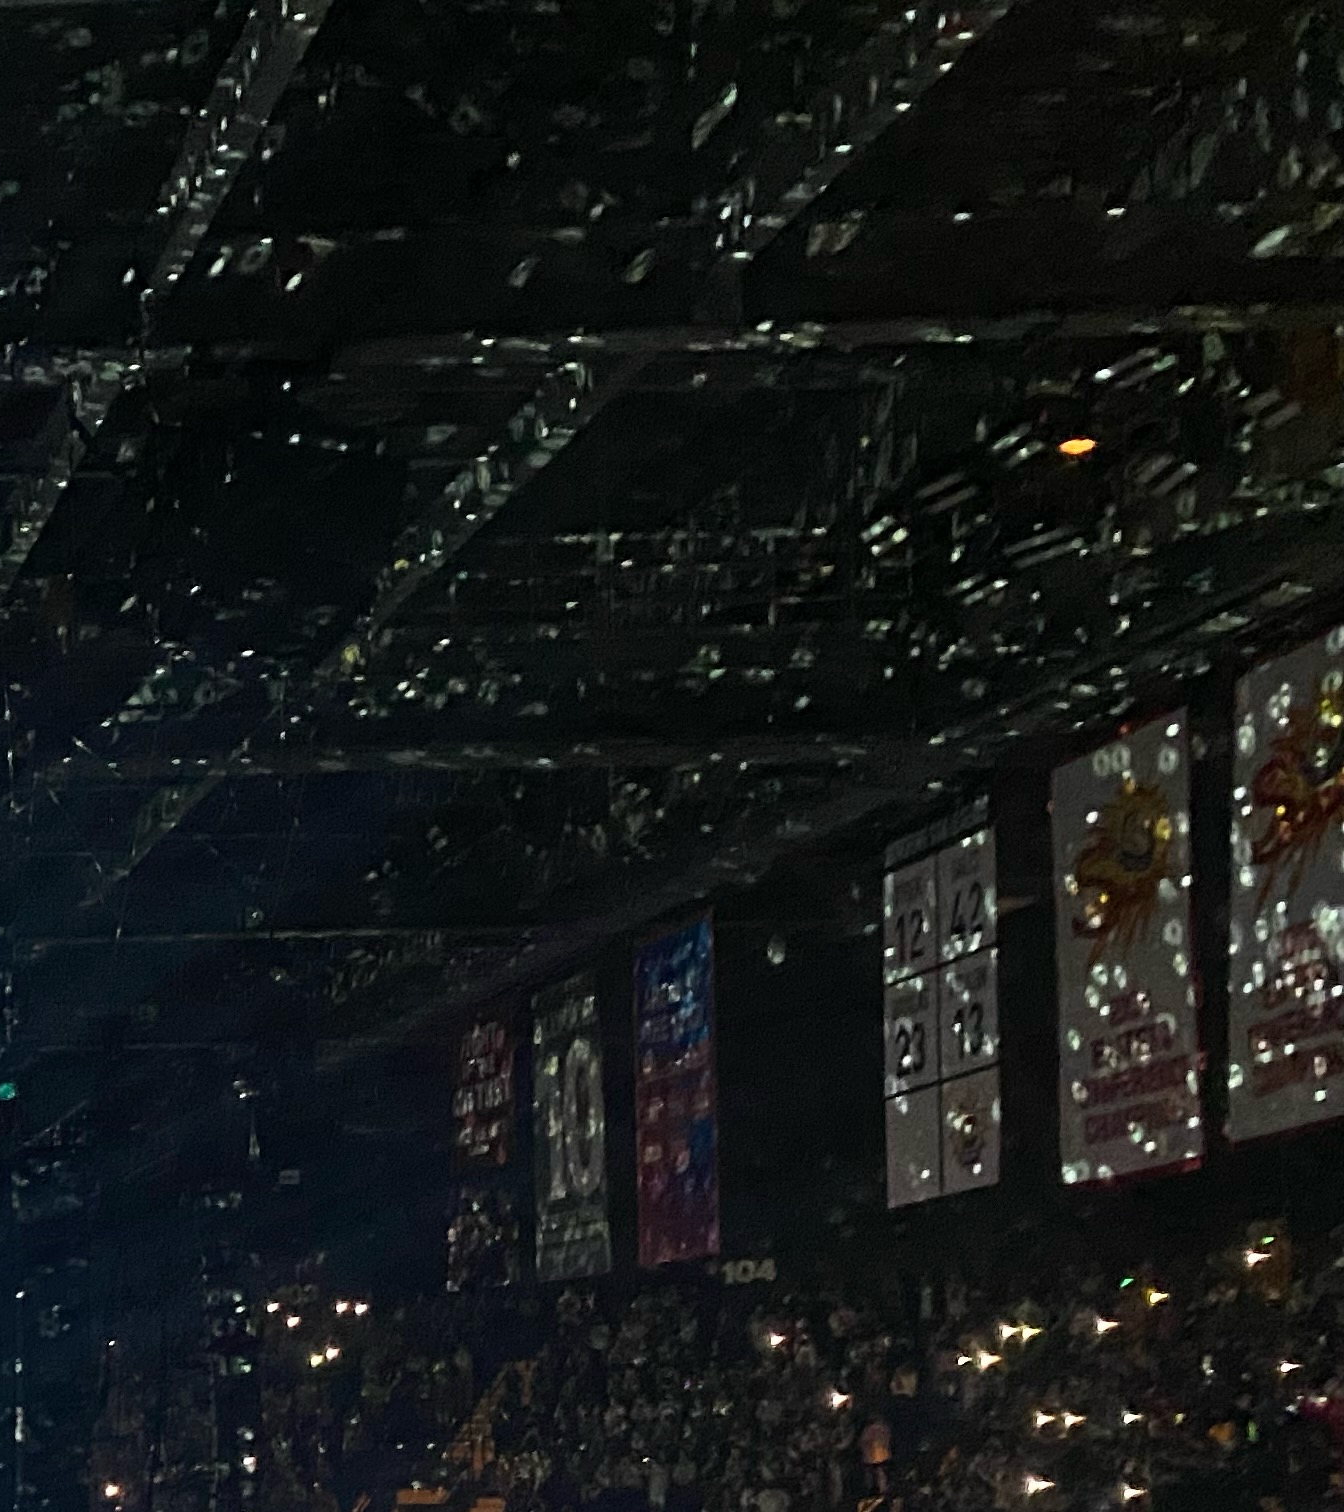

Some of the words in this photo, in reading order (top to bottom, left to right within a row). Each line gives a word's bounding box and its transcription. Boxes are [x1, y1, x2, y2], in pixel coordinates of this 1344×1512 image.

[895, 908, 925, 963] 12
[895, 1021, 926, 1078] 23
[721, 1257, 778, 1285] 104
